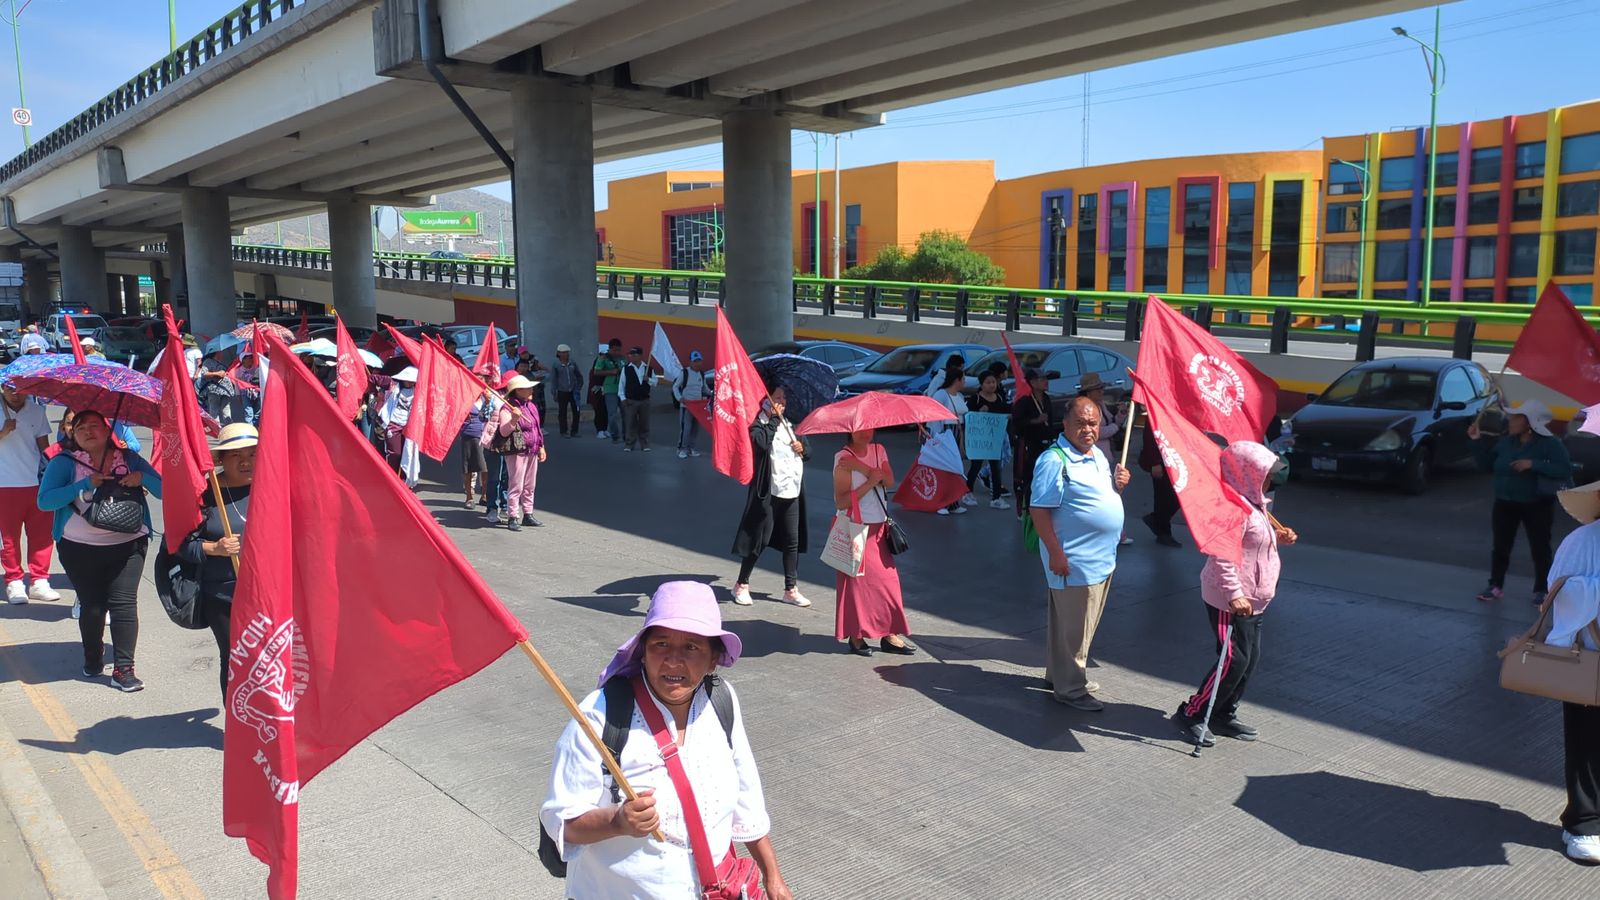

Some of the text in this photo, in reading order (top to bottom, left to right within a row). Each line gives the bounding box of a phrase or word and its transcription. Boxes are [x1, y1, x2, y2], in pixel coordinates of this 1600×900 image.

[16, 111, 27, 120] 40
[1201, 392, 1232, 416] HIDALGO
[235, 686, 250, 722] LUCHA
